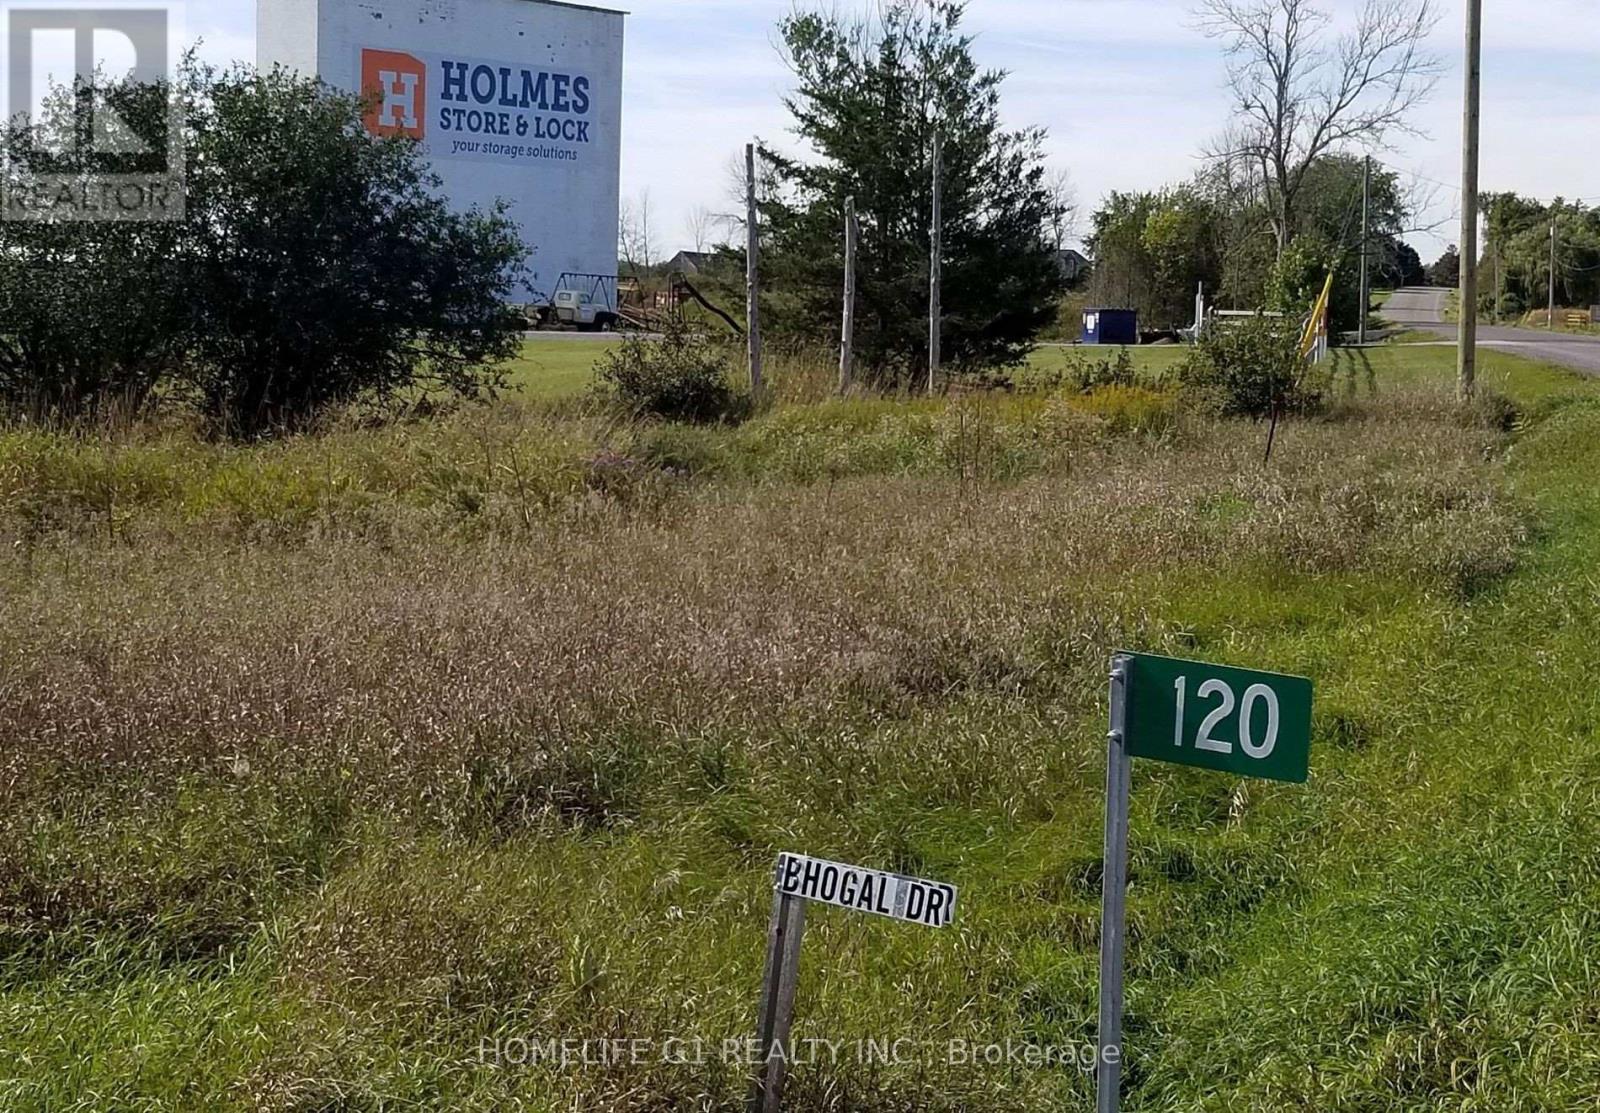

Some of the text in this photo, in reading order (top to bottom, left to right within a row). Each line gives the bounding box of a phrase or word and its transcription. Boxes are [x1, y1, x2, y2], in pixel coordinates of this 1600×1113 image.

[378, 70, 418, 128] H
[440, 60, 590, 115] HOLMES
[440, 107, 590, 143] STORE & LOCK
[451, 140, 578, 161] your storage solutions
[1174, 675, 1280, 759] 120
[782, 856, 944, 926] BHOGAL DR
